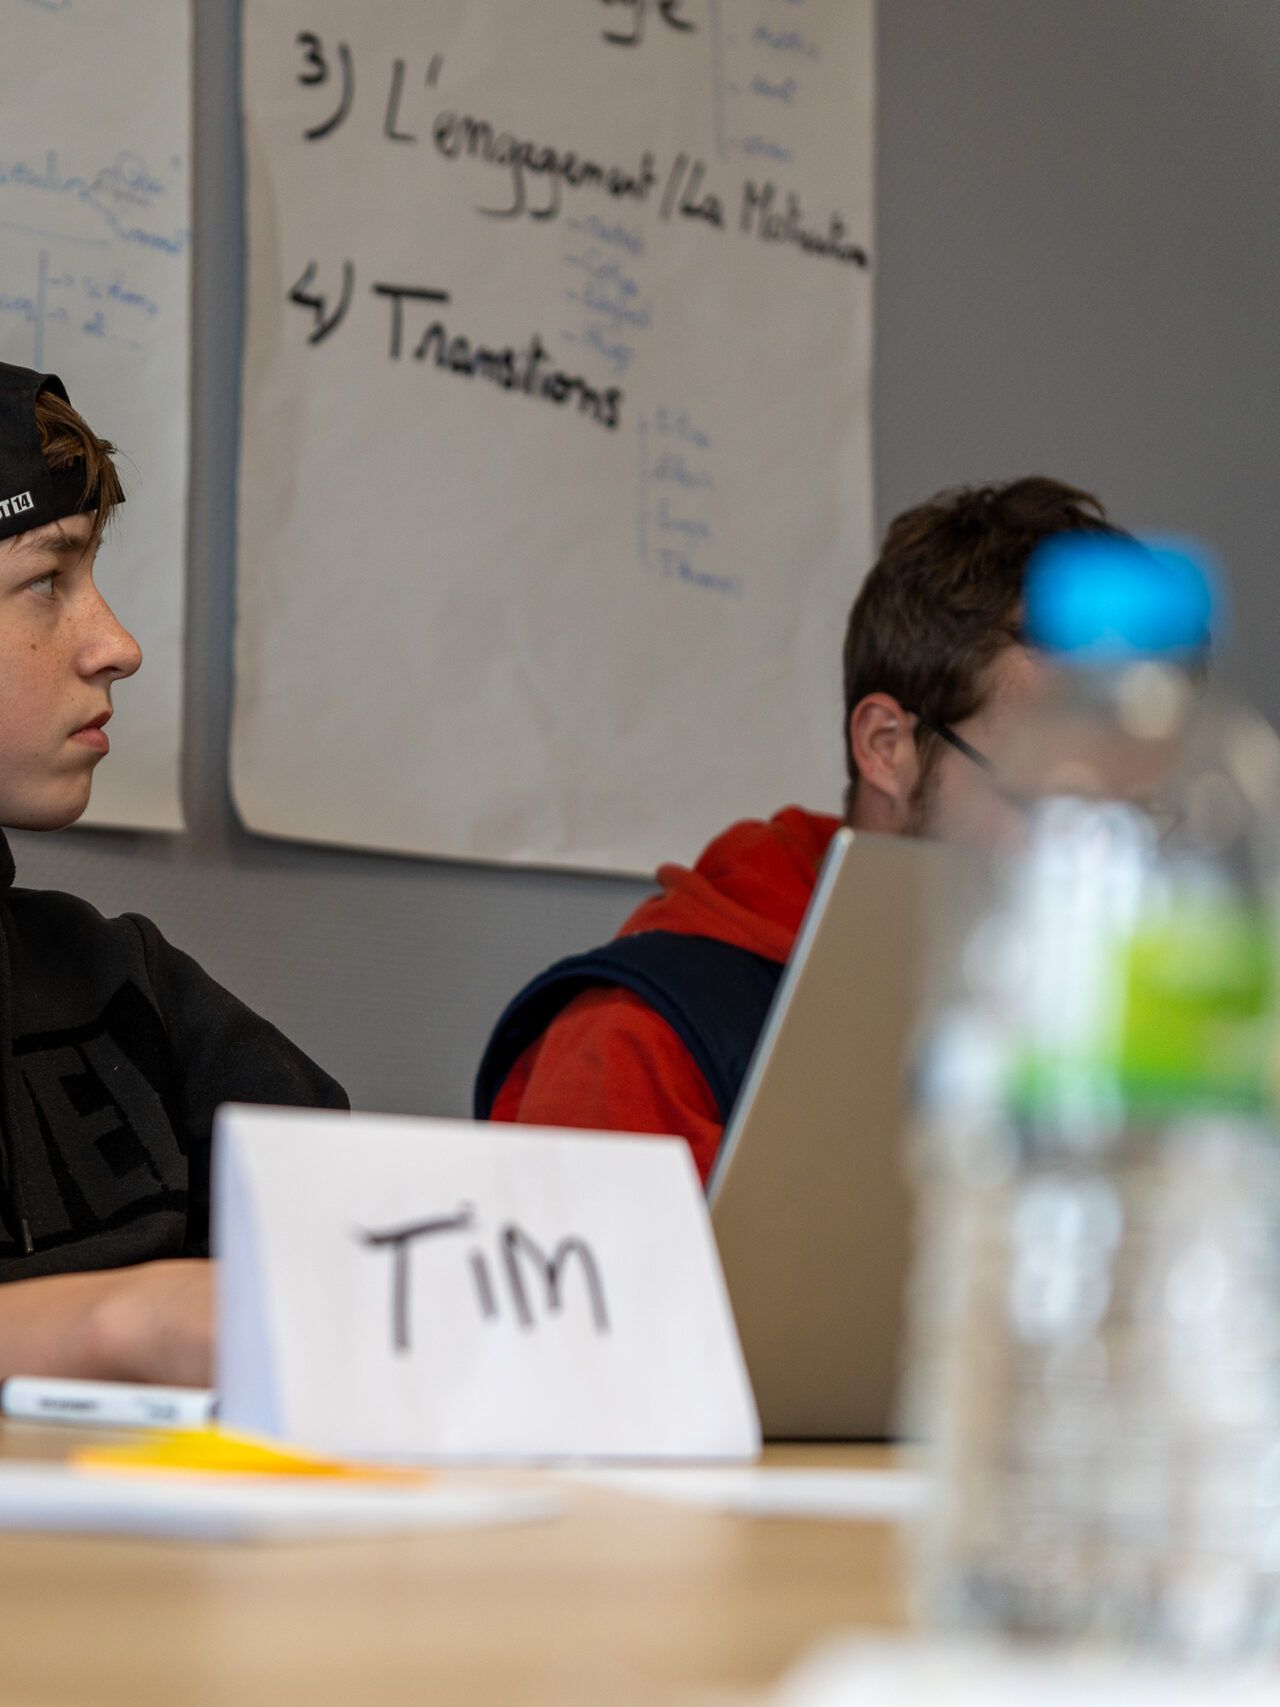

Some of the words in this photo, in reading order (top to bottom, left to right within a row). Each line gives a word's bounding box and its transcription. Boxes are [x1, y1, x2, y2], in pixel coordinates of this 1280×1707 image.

[297, 30, 354, 140] 3)
[288, 261, 357, 347] 4)
[12, 492, 33, 514] 14
